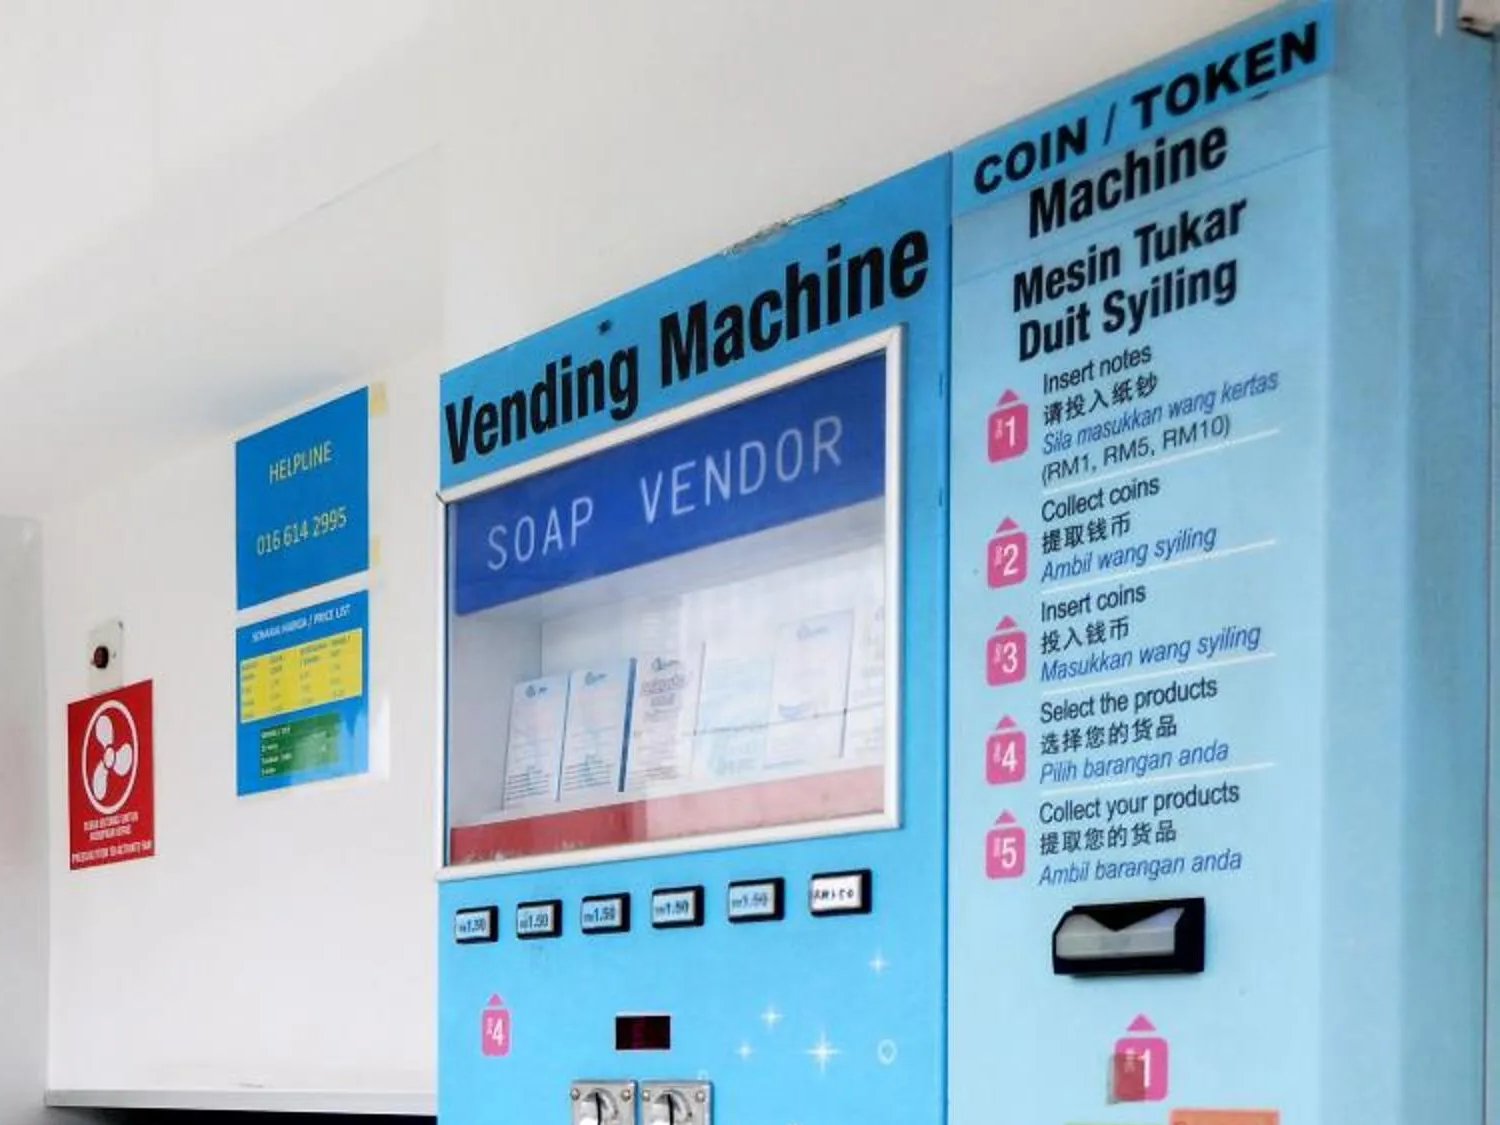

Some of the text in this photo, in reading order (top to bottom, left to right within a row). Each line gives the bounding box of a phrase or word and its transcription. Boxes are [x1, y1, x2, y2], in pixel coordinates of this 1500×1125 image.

[973, 116, 1088, 194] COIN
[1132, 21, 1318, 129] TOKEN
[1029, 125, 1228, 239] Machine
[1012, 198, 1248, 313] Mesin Tukar
[1018, 259, 1238, 362] Duit Syiling
[445, 227, 929, 465] Vending Machine
[1043, 345, 1152, 395] Insert notes
[1042, 428, 1074, 456] Sila
[1077, 402, 1162, 446] masukkan
[1168, 390, 1216, 422] wang
[1220, 370, 1280, 404] kertas
[1043, 372, 1158, 426] 请投入纸钞
[269, 440, 333, 485] HELPLINE
[1041, 413, 1231, 487] (RM1, RM5, RM10)
[487, 414, 844, 571] SOAP VENDOR
[1041, 475, 1160, 522] Collect coins
[257, 504, 348, 556] 016 614 2995
[1041, 512, 1131, 556] 提取钱币
[1041, 527, 1218, 584] Ambil wang syiling
[1041, 584, 1147, 623] Insert coins
[1041, 616, 1130, 655] 投入钱币
[1041, 624, 1262, 683] Masukkan wang syiling
[1041, 676, 1218, 724] Select the products
[1040, 714, 1177, 756] 选择您的货品
[1040, 740, 1229, 785] Pilih barangan anda
[1040, 782, 1240, 824] Collect your products
[1040, 819, 1177, 856] 提取您的货品
[1038, 848, 1242, 886] Ambil barangan anda
